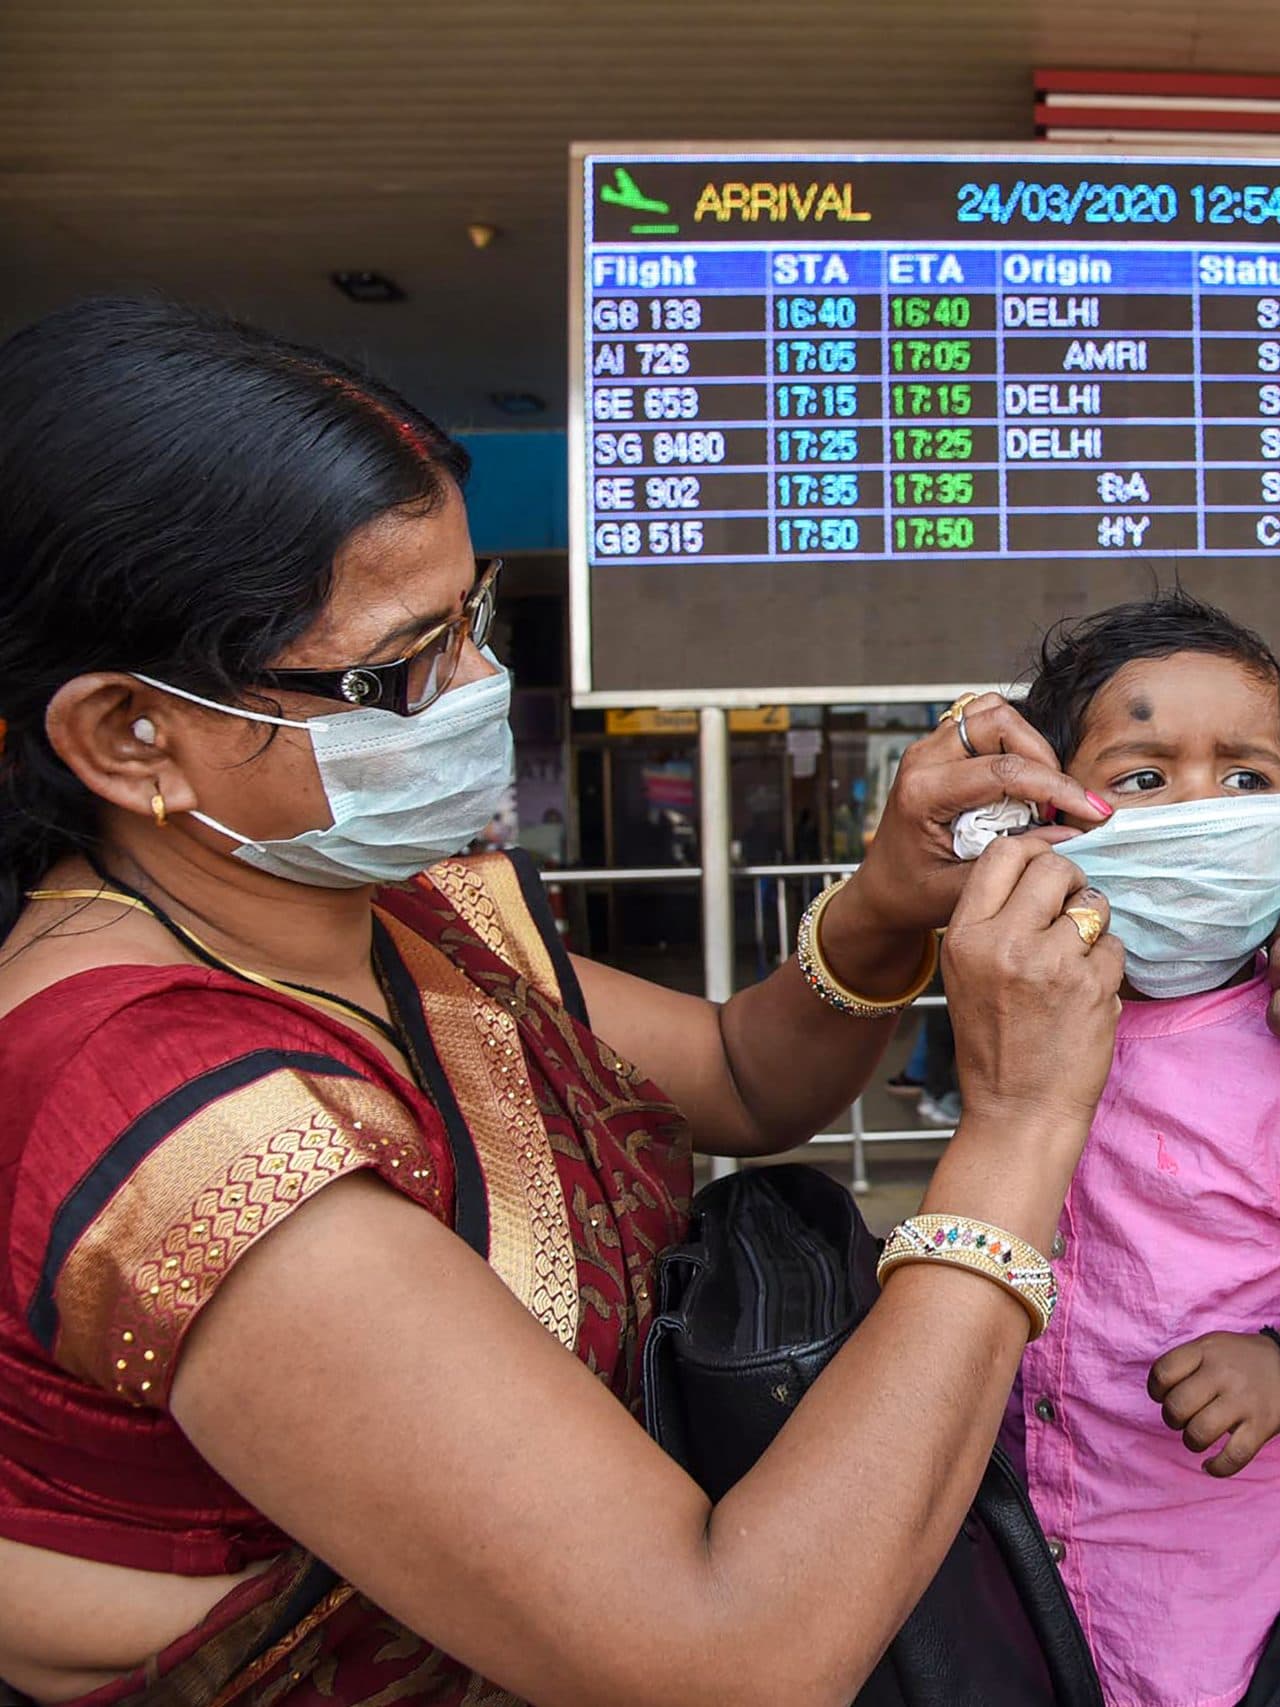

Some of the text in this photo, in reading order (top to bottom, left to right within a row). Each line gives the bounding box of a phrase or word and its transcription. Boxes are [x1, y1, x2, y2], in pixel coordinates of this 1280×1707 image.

[695, 183, 871, 221] ARRIVAL
[958, 181, 1177, 224] 24/03/2020
[591, 256, 695, 287] Flight
[777, 254, 848, 283] STA
[890, 254, 963, 282] ETA
[1005, 255, 1111, 285] Origin
[650, 299, 701, 332] 133
[775, 298, 856, 328] 16:40
[892, 298, 969, 327] 16:40
[1004, 297, 1099, 327] DELHI
[592, 341, 624, 377] AI
[636, 343, 690, 374] 726
[775, 341, 856, 373] 17:05
[893, 341, 970, 375] 17:05
[1063, 341, 1147, 370] AMRI
[592, 386, 633, 422] 6E
[644, 387, 698, 422] 653
[775, 383, 857, 415] 17:15
[893, 385, 971, 414] 17:15
[1005, 384, 1100, 414] DELHI
[592, 431, 643, 467] SG
[654, 432, 725, 466] 8480
[776, 430, 858, 462] 17:25
[894, 429, 972, 459] 17:25
[1006, 428, 1102, 458] DELHI
[592, 476, 635, 512] 6E
[646, 477, 700, 509] 902
[776, 473, 858, 505] 17:35
[894, 473, 973, 504] 17:35
[649, 521, 703, 554] 515
[777, 519, 859, 551] 17:50
[896, 518, 973, 548] 17:50
